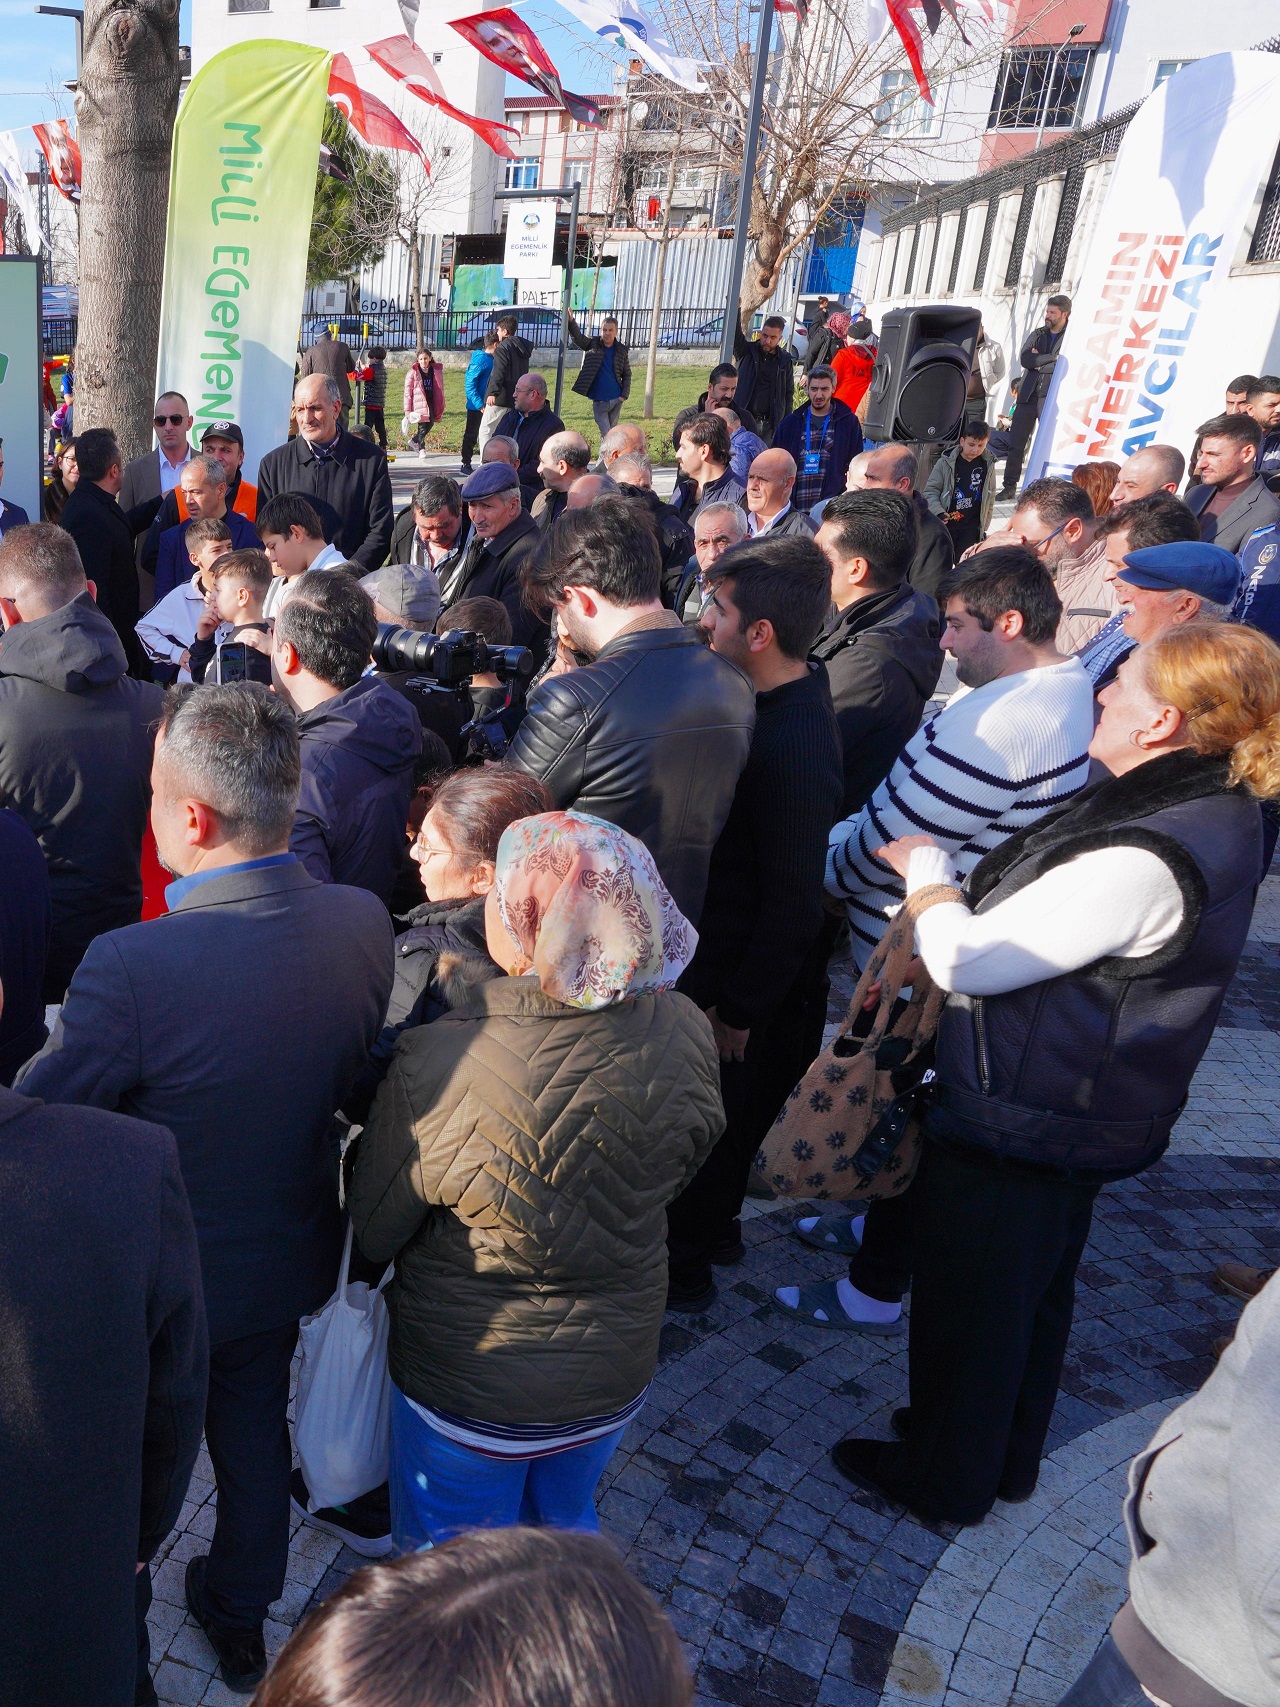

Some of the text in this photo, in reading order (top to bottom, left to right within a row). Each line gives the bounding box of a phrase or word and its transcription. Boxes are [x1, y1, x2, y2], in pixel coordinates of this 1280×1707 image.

[522, 290, 560, 306] PALET
[1056, 232, 1148, 452] YAŞAMIN
[1087, 235, 1186, 459] MERKEZİ
[1120, 232, 1225, 457] AVCILAR
